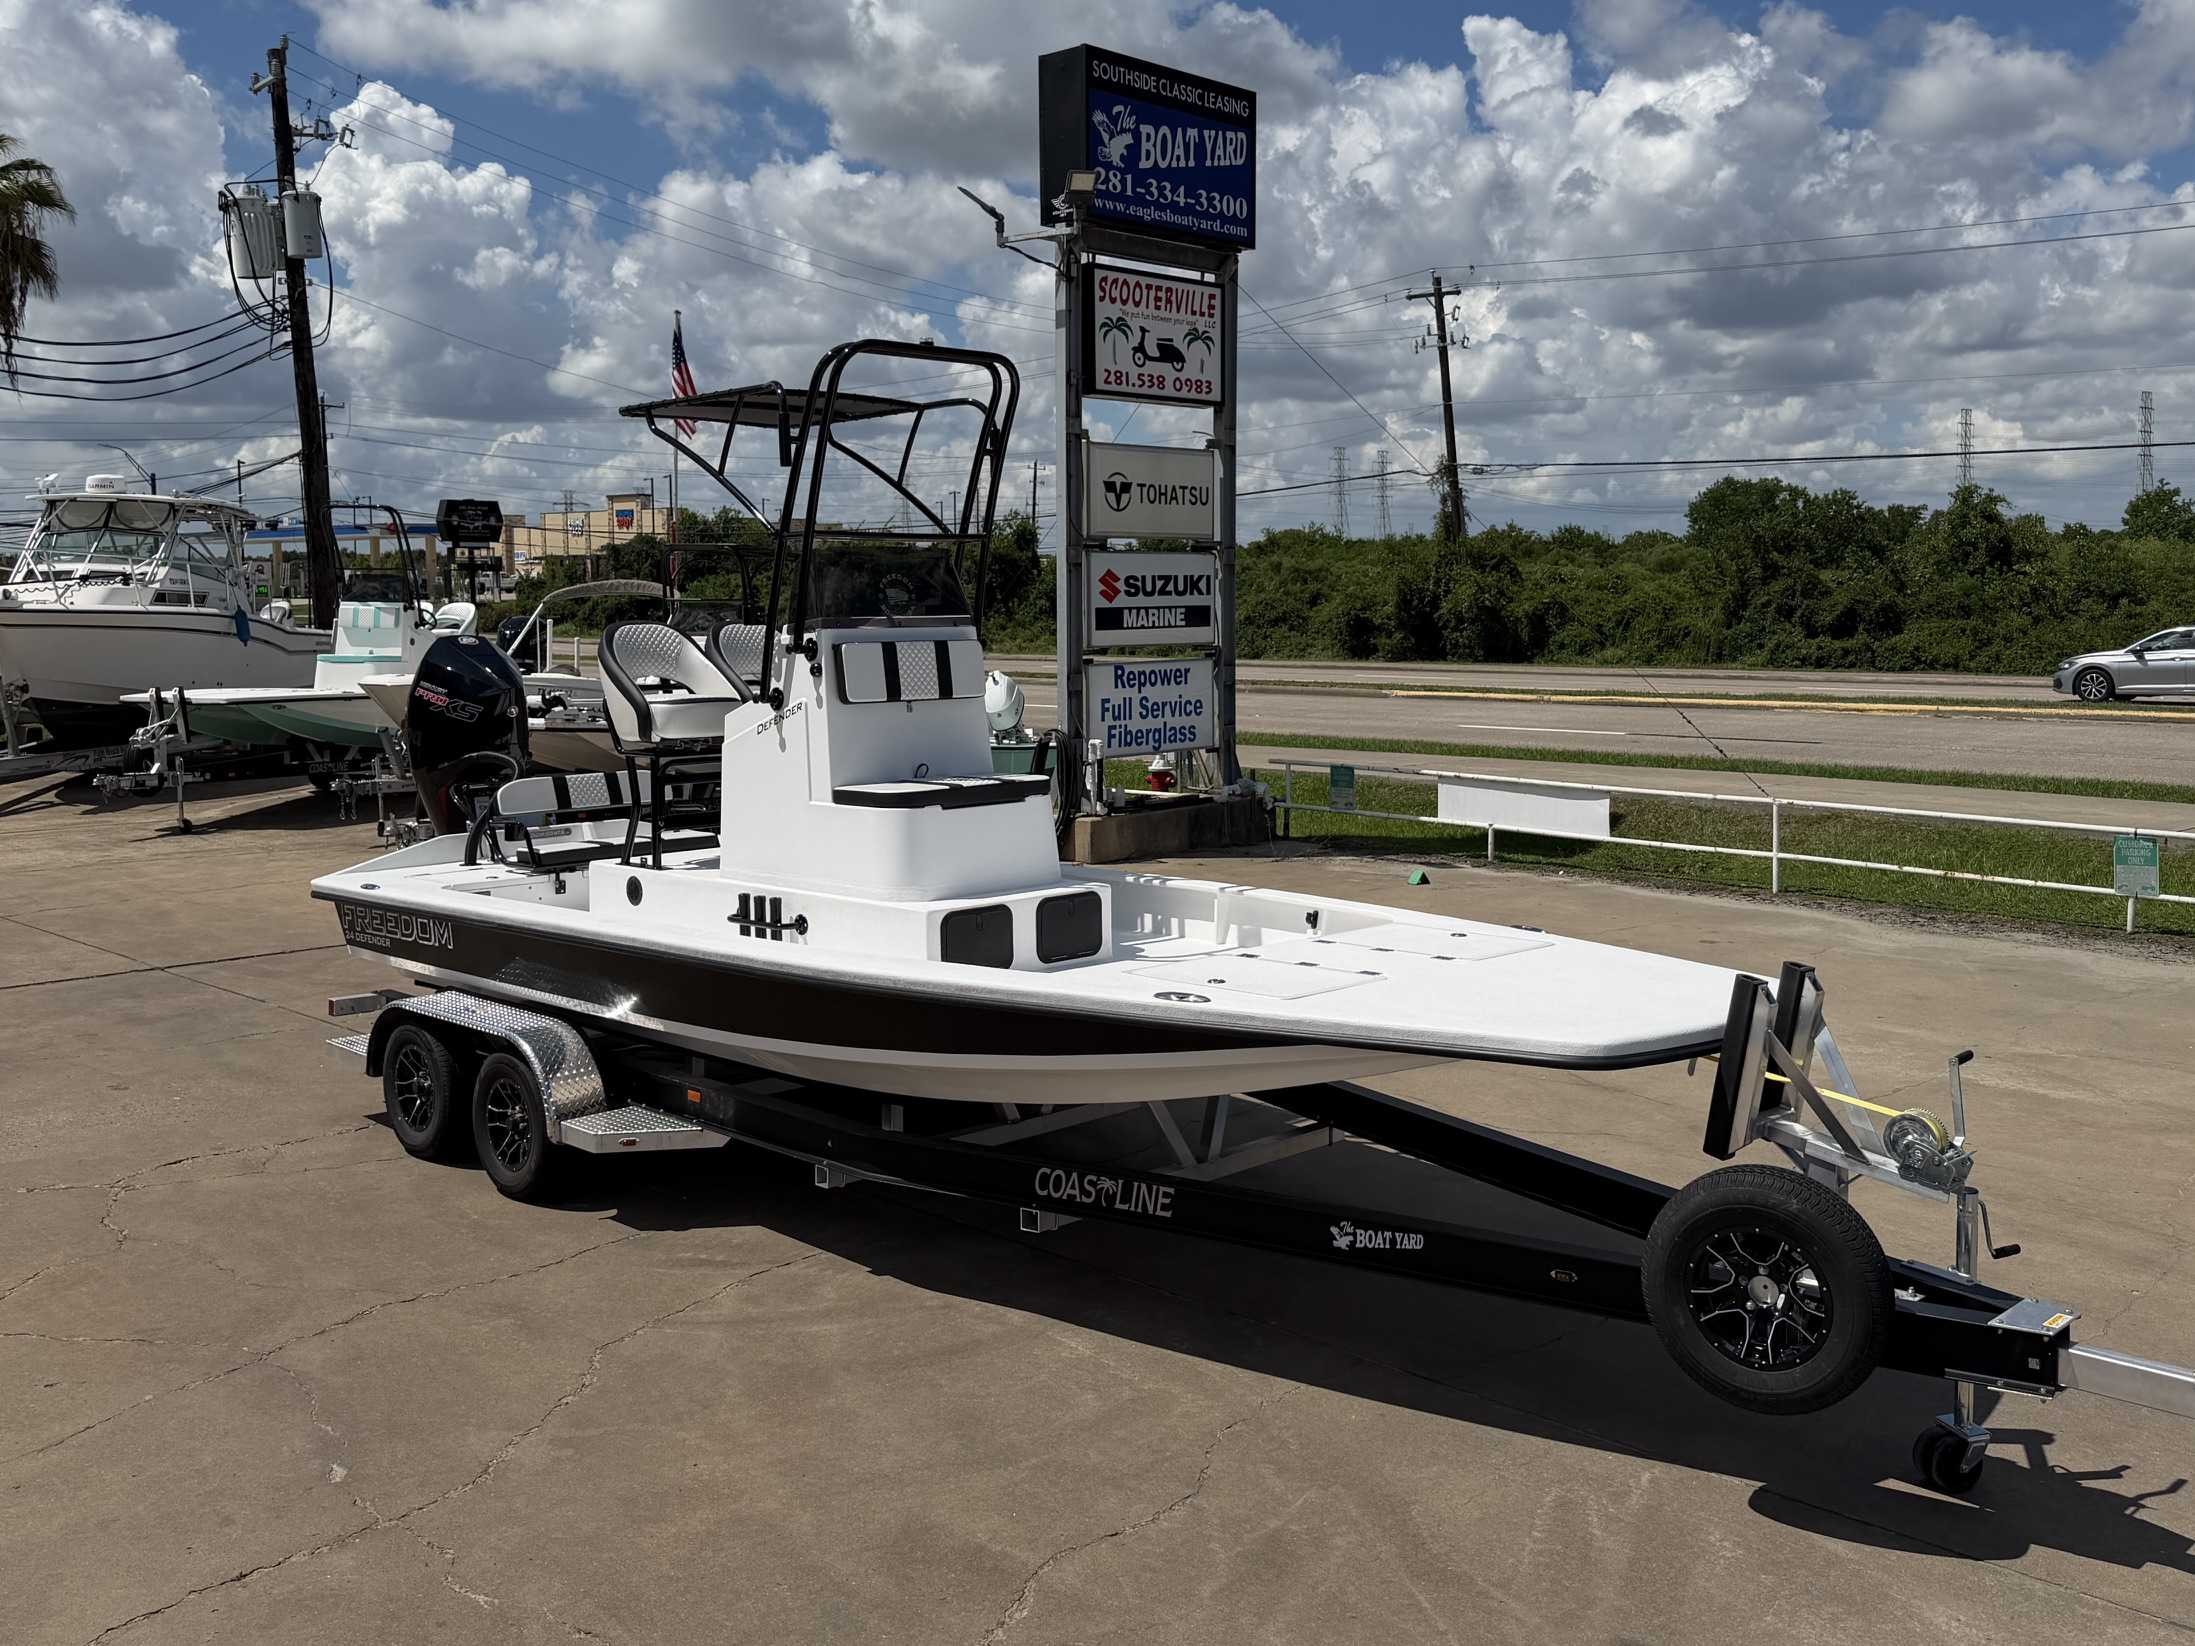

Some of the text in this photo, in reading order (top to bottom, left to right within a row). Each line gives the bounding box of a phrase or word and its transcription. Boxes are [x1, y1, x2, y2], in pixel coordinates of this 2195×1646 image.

[1092, 60, 1249, 117] SOUTHSIDE CLASSIC LEASING
[1112, 104, 1137, 130] The
[1139, 124, 1248, 169] BOAT YARD
[1094, 167, 1248, 219] 281-334-3300
[1094, 198, 1248, 237] www.eaglesboatyard.com
[1098, 275, 1217, 319] SCOOTERVILLE
[1204, 320, 1216, 329] LLC
[1103, 368, 1213, 395] 281.538 0983
[1137, 482, 1209, 506] TOHATSU
[1124, 574, 1211, 598] SUZUKI
[1123, 607, 1186, 628] MARINE
[1113, 664, 1191, 694] Repower
[414, 687, 449, 707] PRO
[1100, 694, 1204, 722] Full Service
[756, 701, 803, 735] DEFENDER
[1106, 720, 1197, 750] Fiberglass
[2127, 856, 2145, 865] ONLY
[343, 904, 454, 949] FREEDOM
[355, 932, 391, 949] DEFENDER
[1355, 1229, 1424, 1249] BOAT YARD
